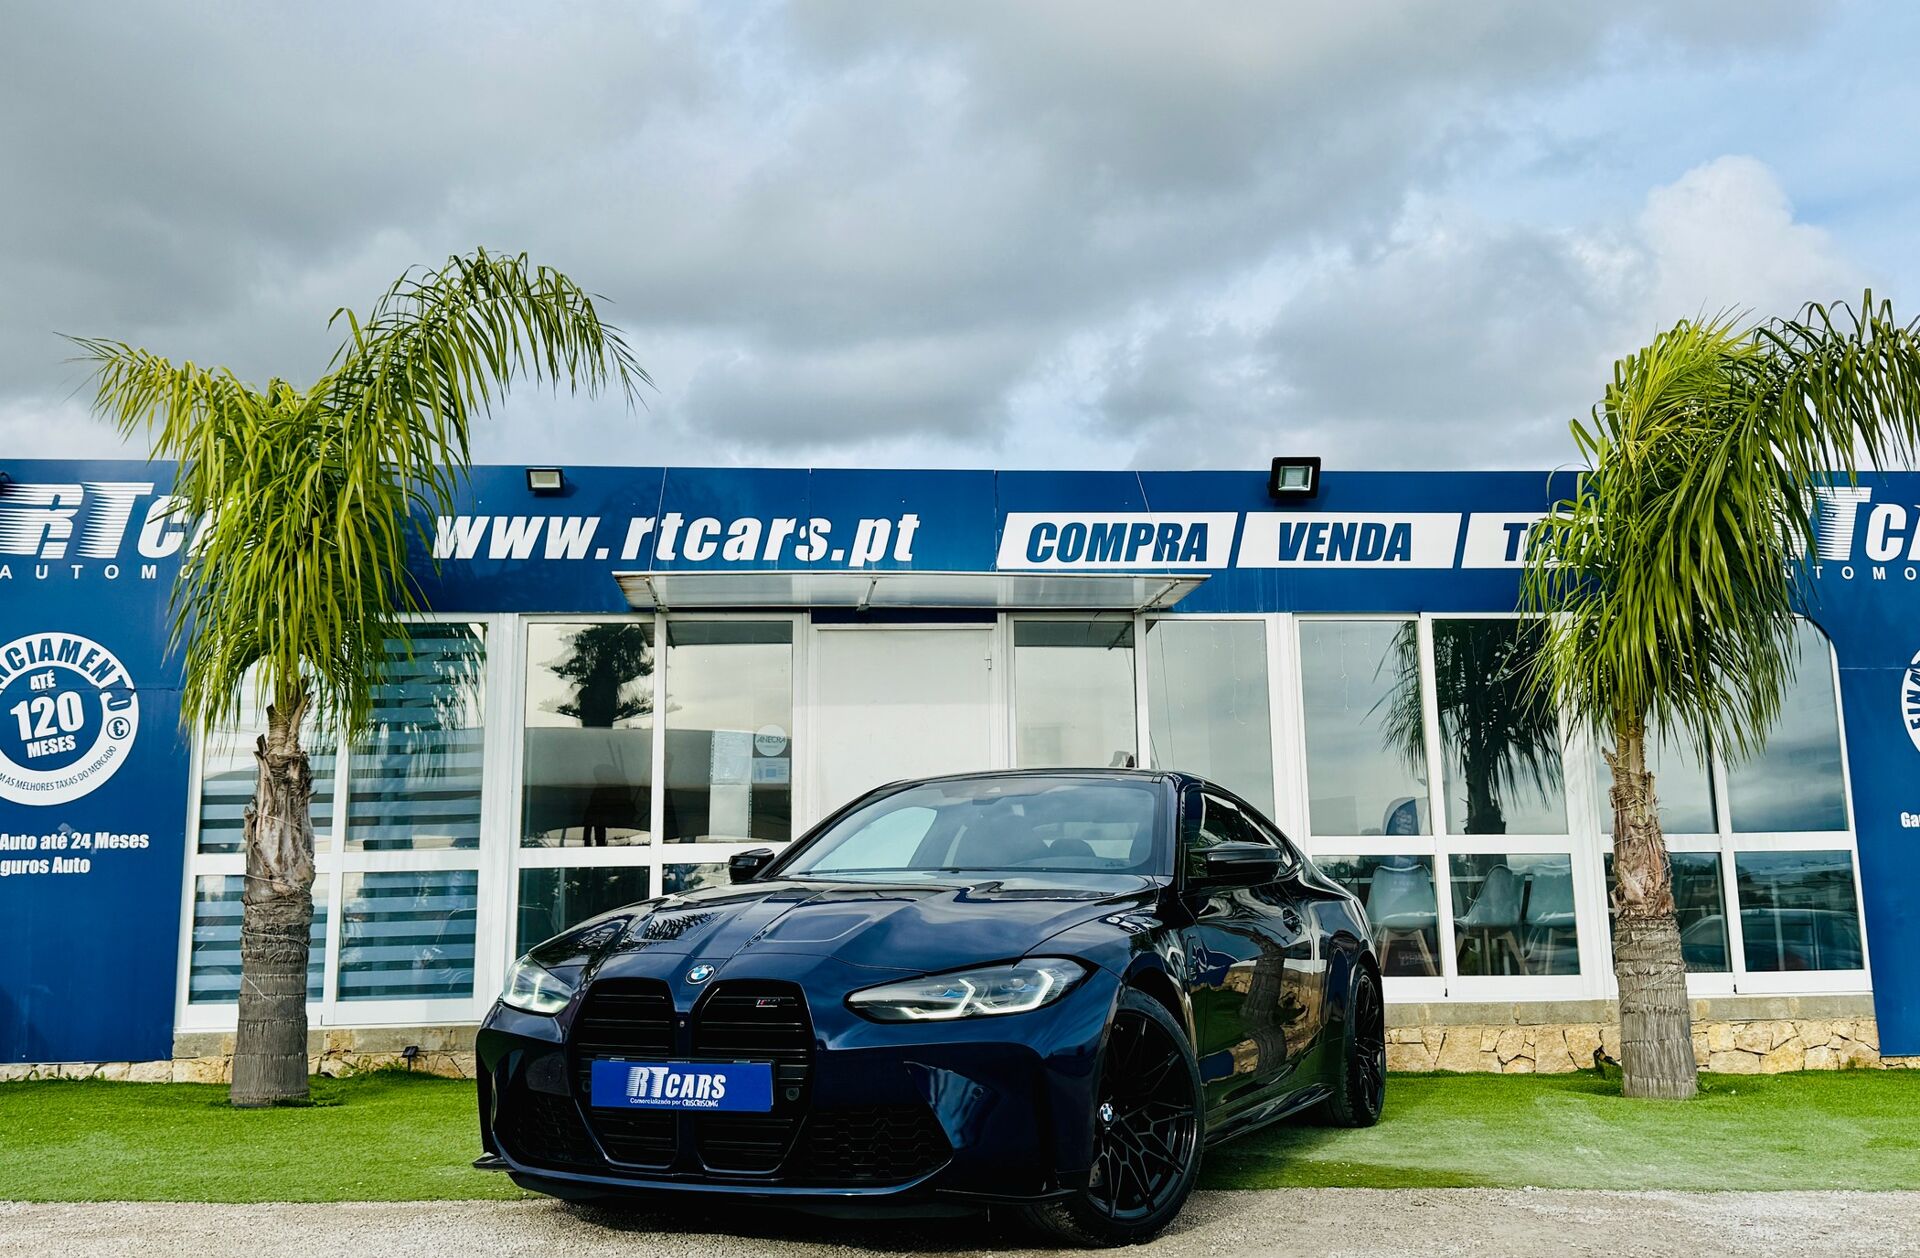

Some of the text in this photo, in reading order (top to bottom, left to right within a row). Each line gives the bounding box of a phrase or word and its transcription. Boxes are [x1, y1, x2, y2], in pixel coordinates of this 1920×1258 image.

[432, 514, 919, 567] www.rtcars.pt
[1026, 522, 1208, 562] COMPRA
[1279, 522, 1412, 561] VENDA
[30, 670, 56, 691] ATÉ
[10, 691, 84, 741] 120
[26, 735, 77, 759] MESES
[15, 780, 55, 791] MELHORES
[56, 776, 79, 790] TAXAS
[78, 770, 90, 781] DO
[89, 745, 117, 774] MERCADO
[0, 832, 150, 851] Auto até 24 Meses
[51, 856, 91, 874] Auto
[671, 1099, 682, 1107] por
